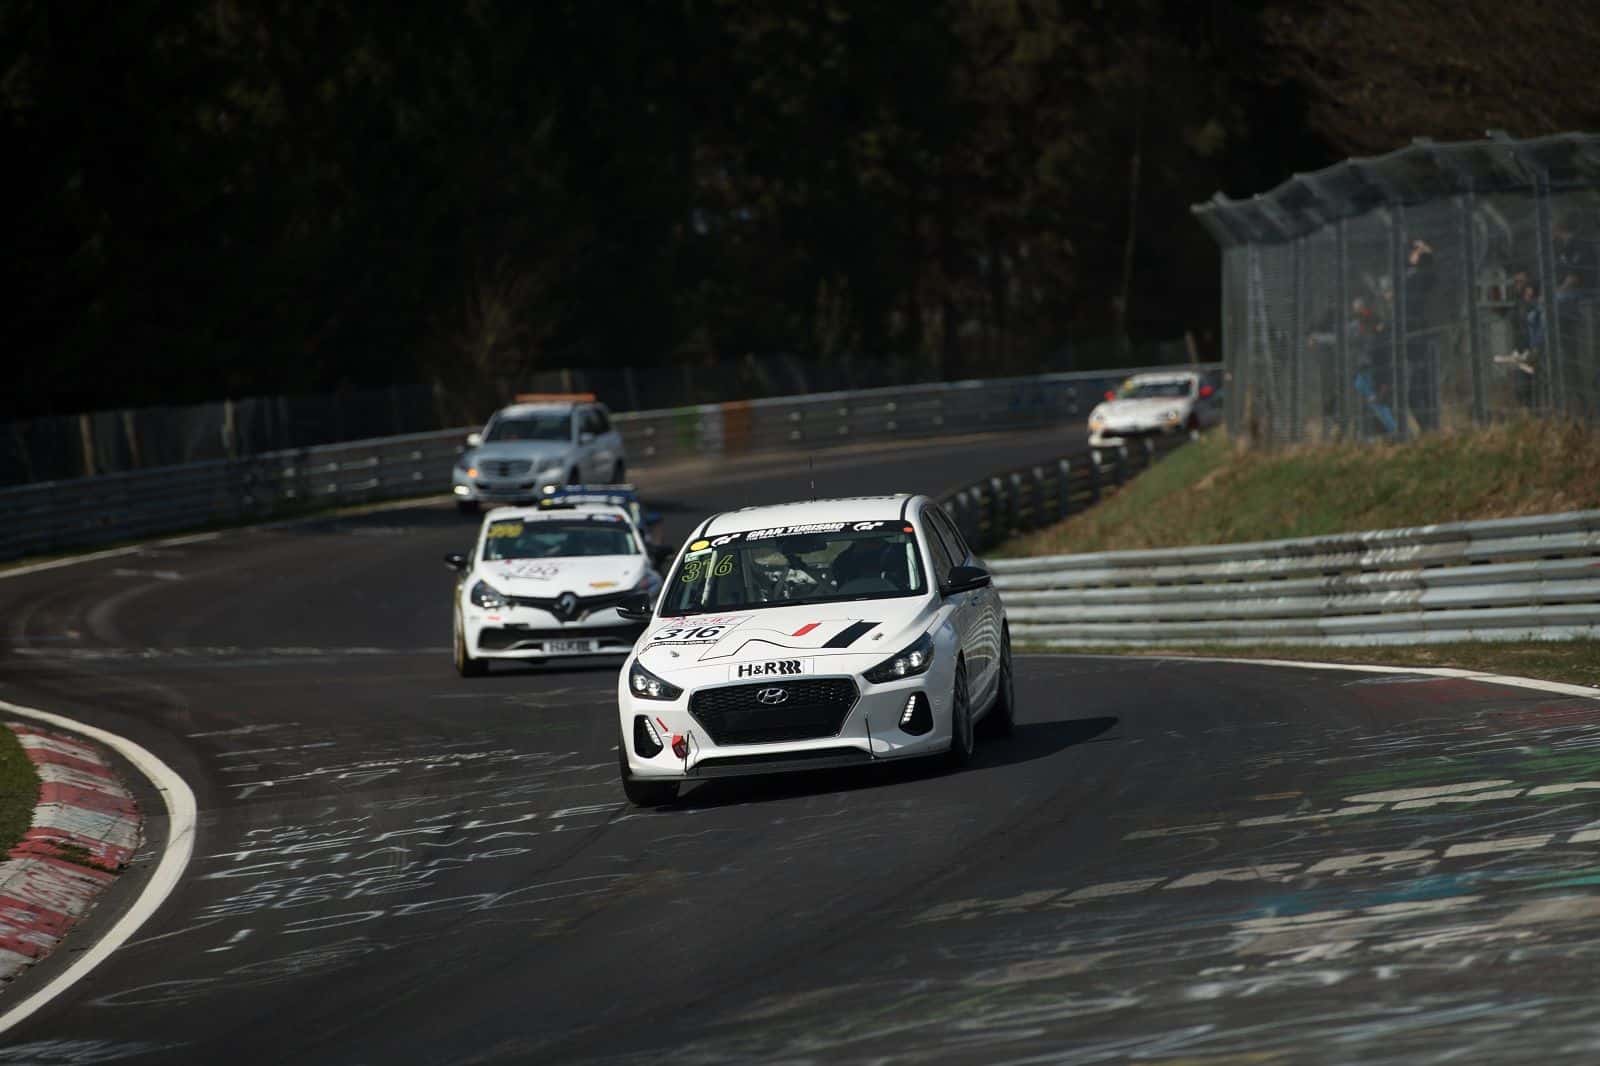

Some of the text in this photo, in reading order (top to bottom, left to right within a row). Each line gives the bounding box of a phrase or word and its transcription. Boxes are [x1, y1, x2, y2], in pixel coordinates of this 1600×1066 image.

[746, 527, 784, 539] GRAN
[787, 523, 845, 533] TURISMO
[682, 554, 734, 583] 316
[654, 625, 726, 641] 316
[738, 661, 778, 677] H&R
